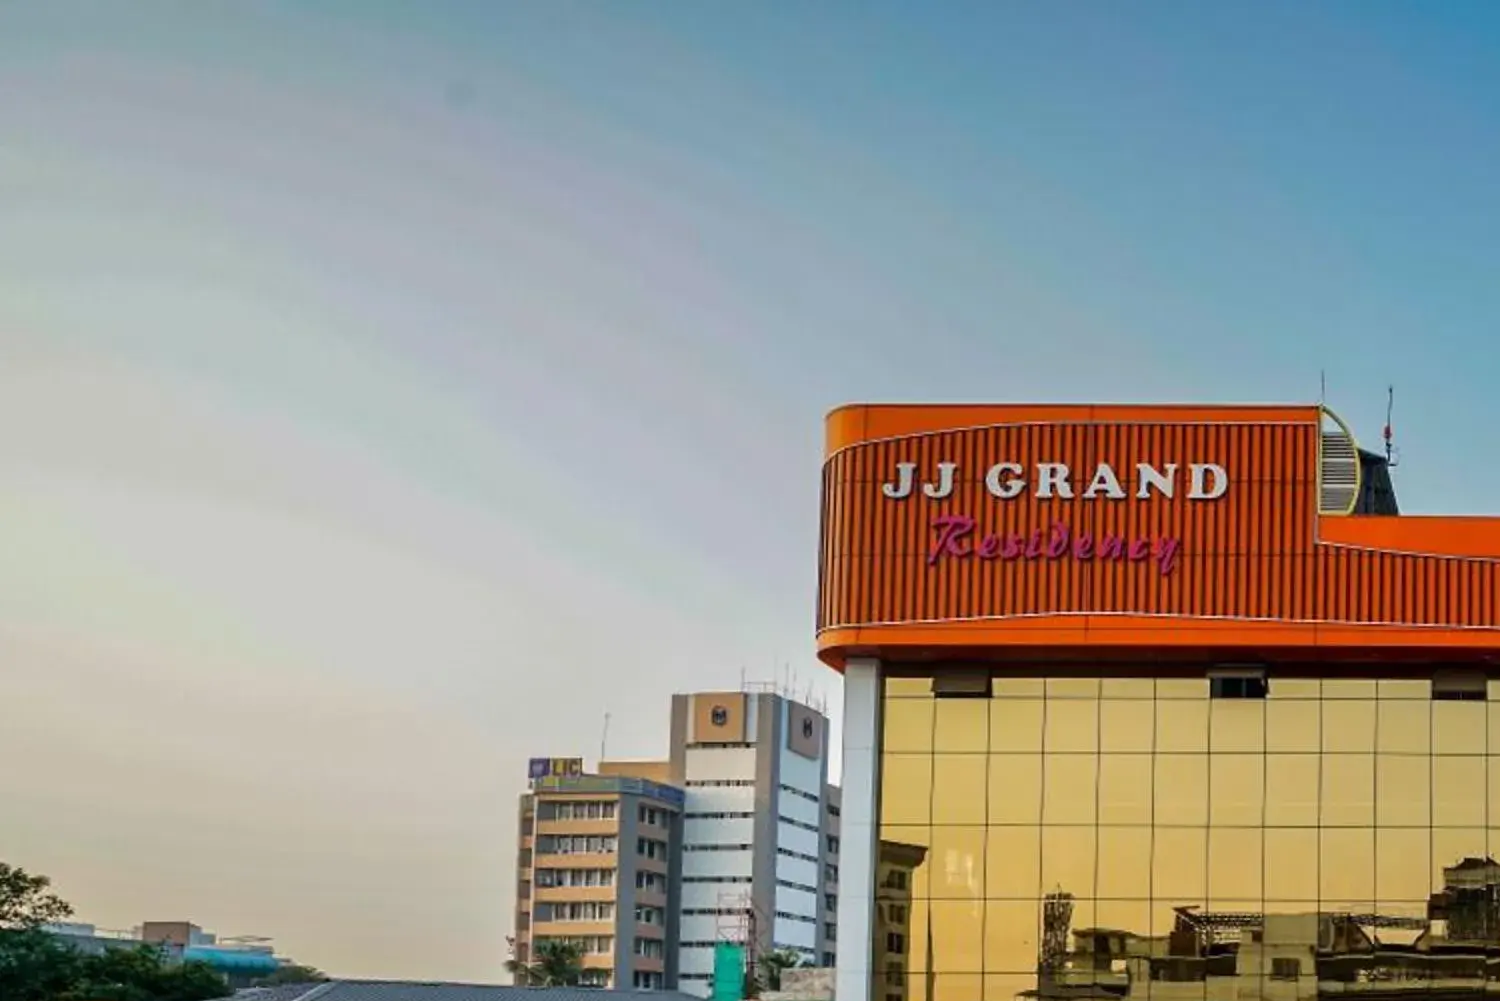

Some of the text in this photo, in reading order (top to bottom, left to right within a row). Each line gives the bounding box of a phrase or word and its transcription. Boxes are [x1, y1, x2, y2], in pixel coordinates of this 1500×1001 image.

[986, 462, 1229, 499] GRAND
[928, 514, 1181, 574] Residency
[552, 759, 580, 777] LIC
